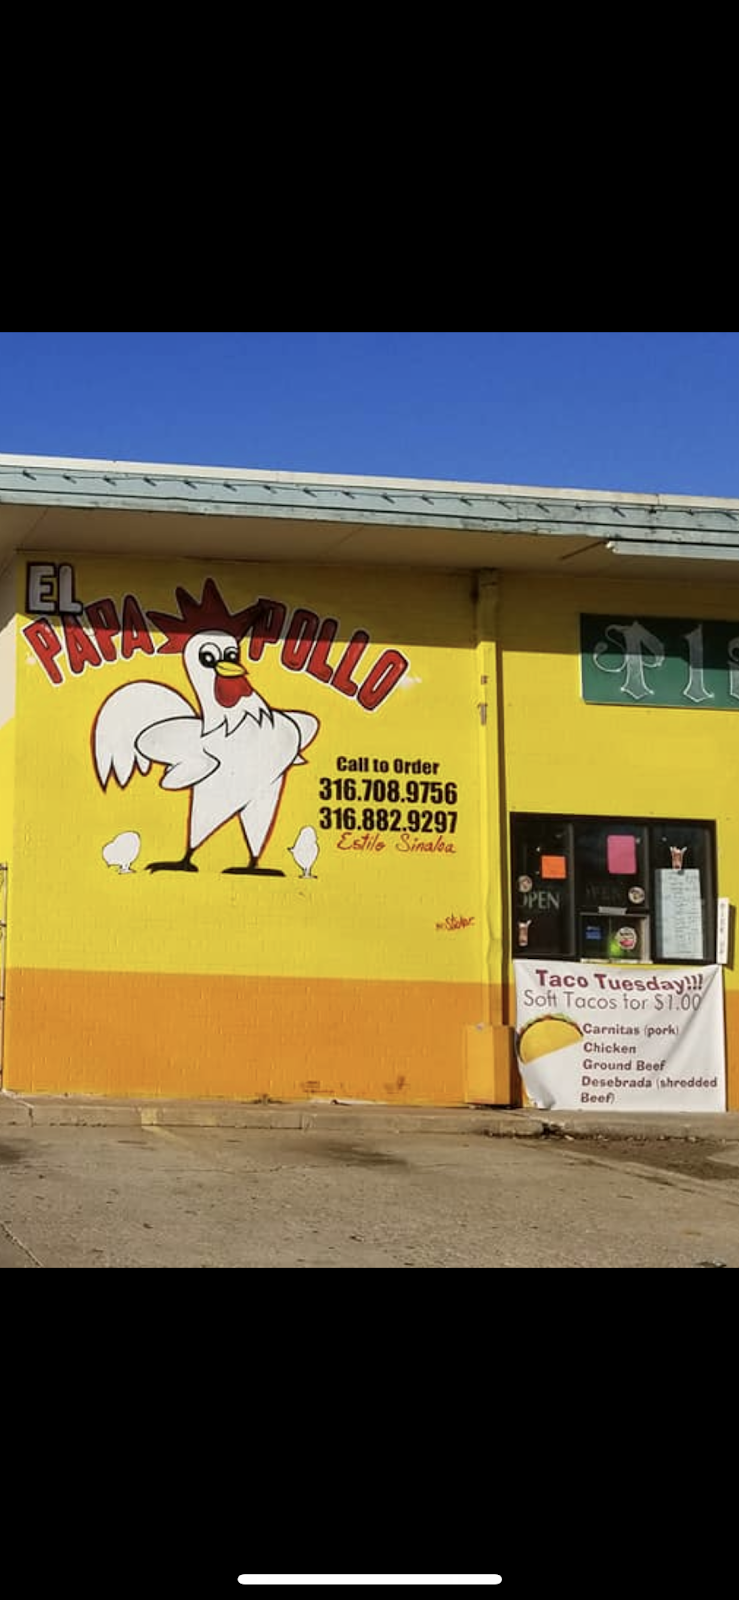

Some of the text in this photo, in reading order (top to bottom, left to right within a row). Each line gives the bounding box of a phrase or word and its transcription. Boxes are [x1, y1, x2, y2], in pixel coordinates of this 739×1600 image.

[26, 562, 84, 615] EL
[21, 594, 409, 711] PAPA POLLO
[336, 755, 440, 775] Call to Order
[319, 777, 458, 805] 316.708.9756
[319, 806, 458, 834] 316.882.9297
[336, 832, 457, 854] Estilo Sinaloa
[535, 969, 704, 995] Taco Tuesday!!!
[523, 989, 701, 1012] Soft Tacos for $1.00
[583, 1023, 679, 1038] Carnitas (pork)
[583, 1042, 637, 1054] Chicken
[583, 1059, 667, 1071] Ground Beef
[581, 1076, 718, 1089] Desebrada (shredded
[580, 1092, 616, 1104] Beef)
